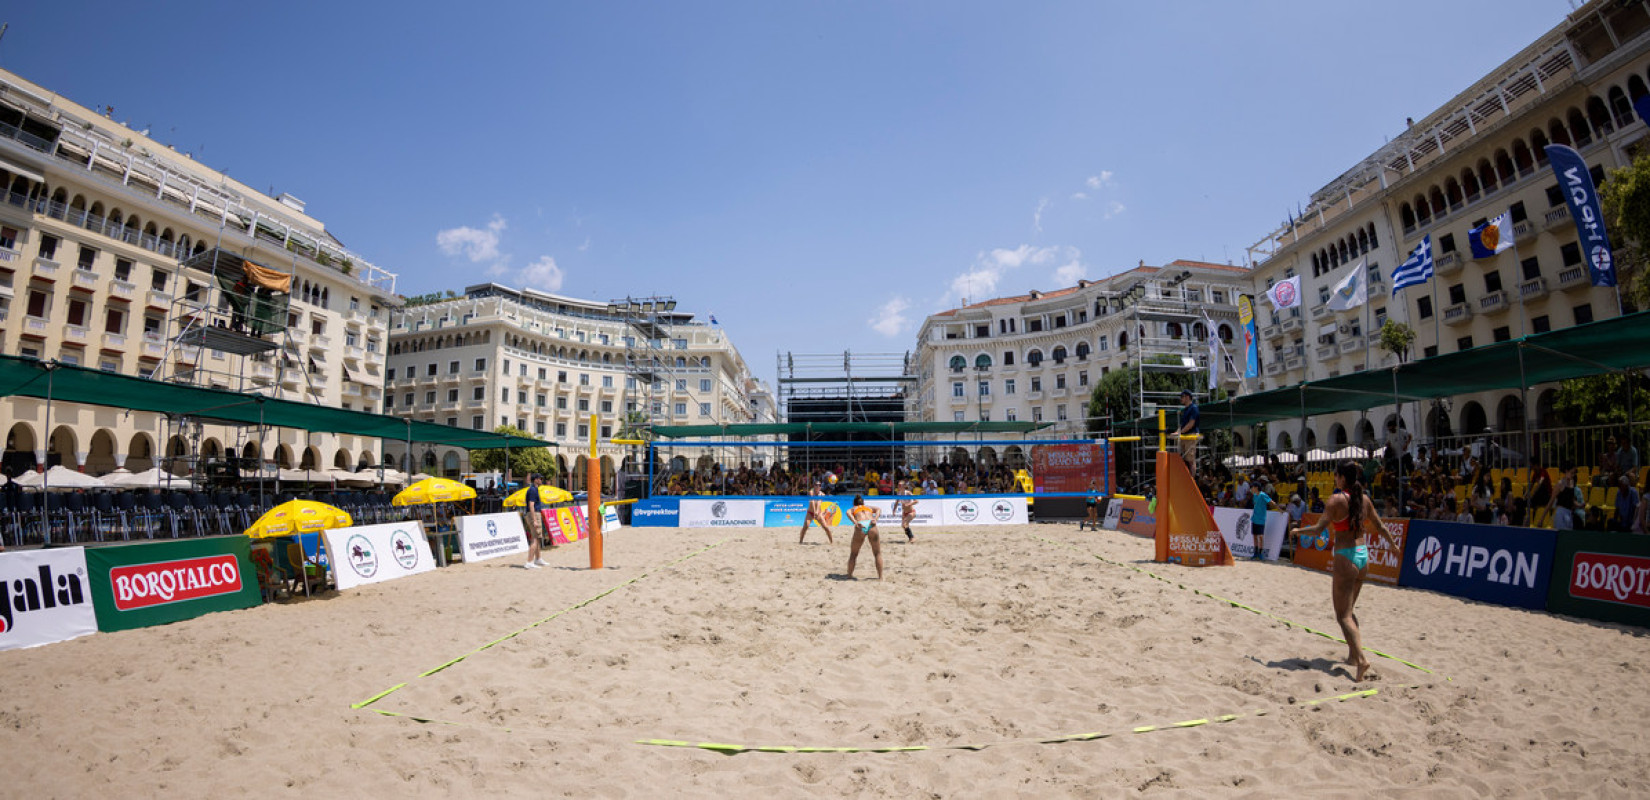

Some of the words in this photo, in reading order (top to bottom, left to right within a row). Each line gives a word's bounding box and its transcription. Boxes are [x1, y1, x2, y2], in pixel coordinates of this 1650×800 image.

[632, 508, 679, 517] @bvgreektour
[115, 562, 237, 601] BOROTALCO
[1444, 543, 1539, 588] ΗΡΩΝ
